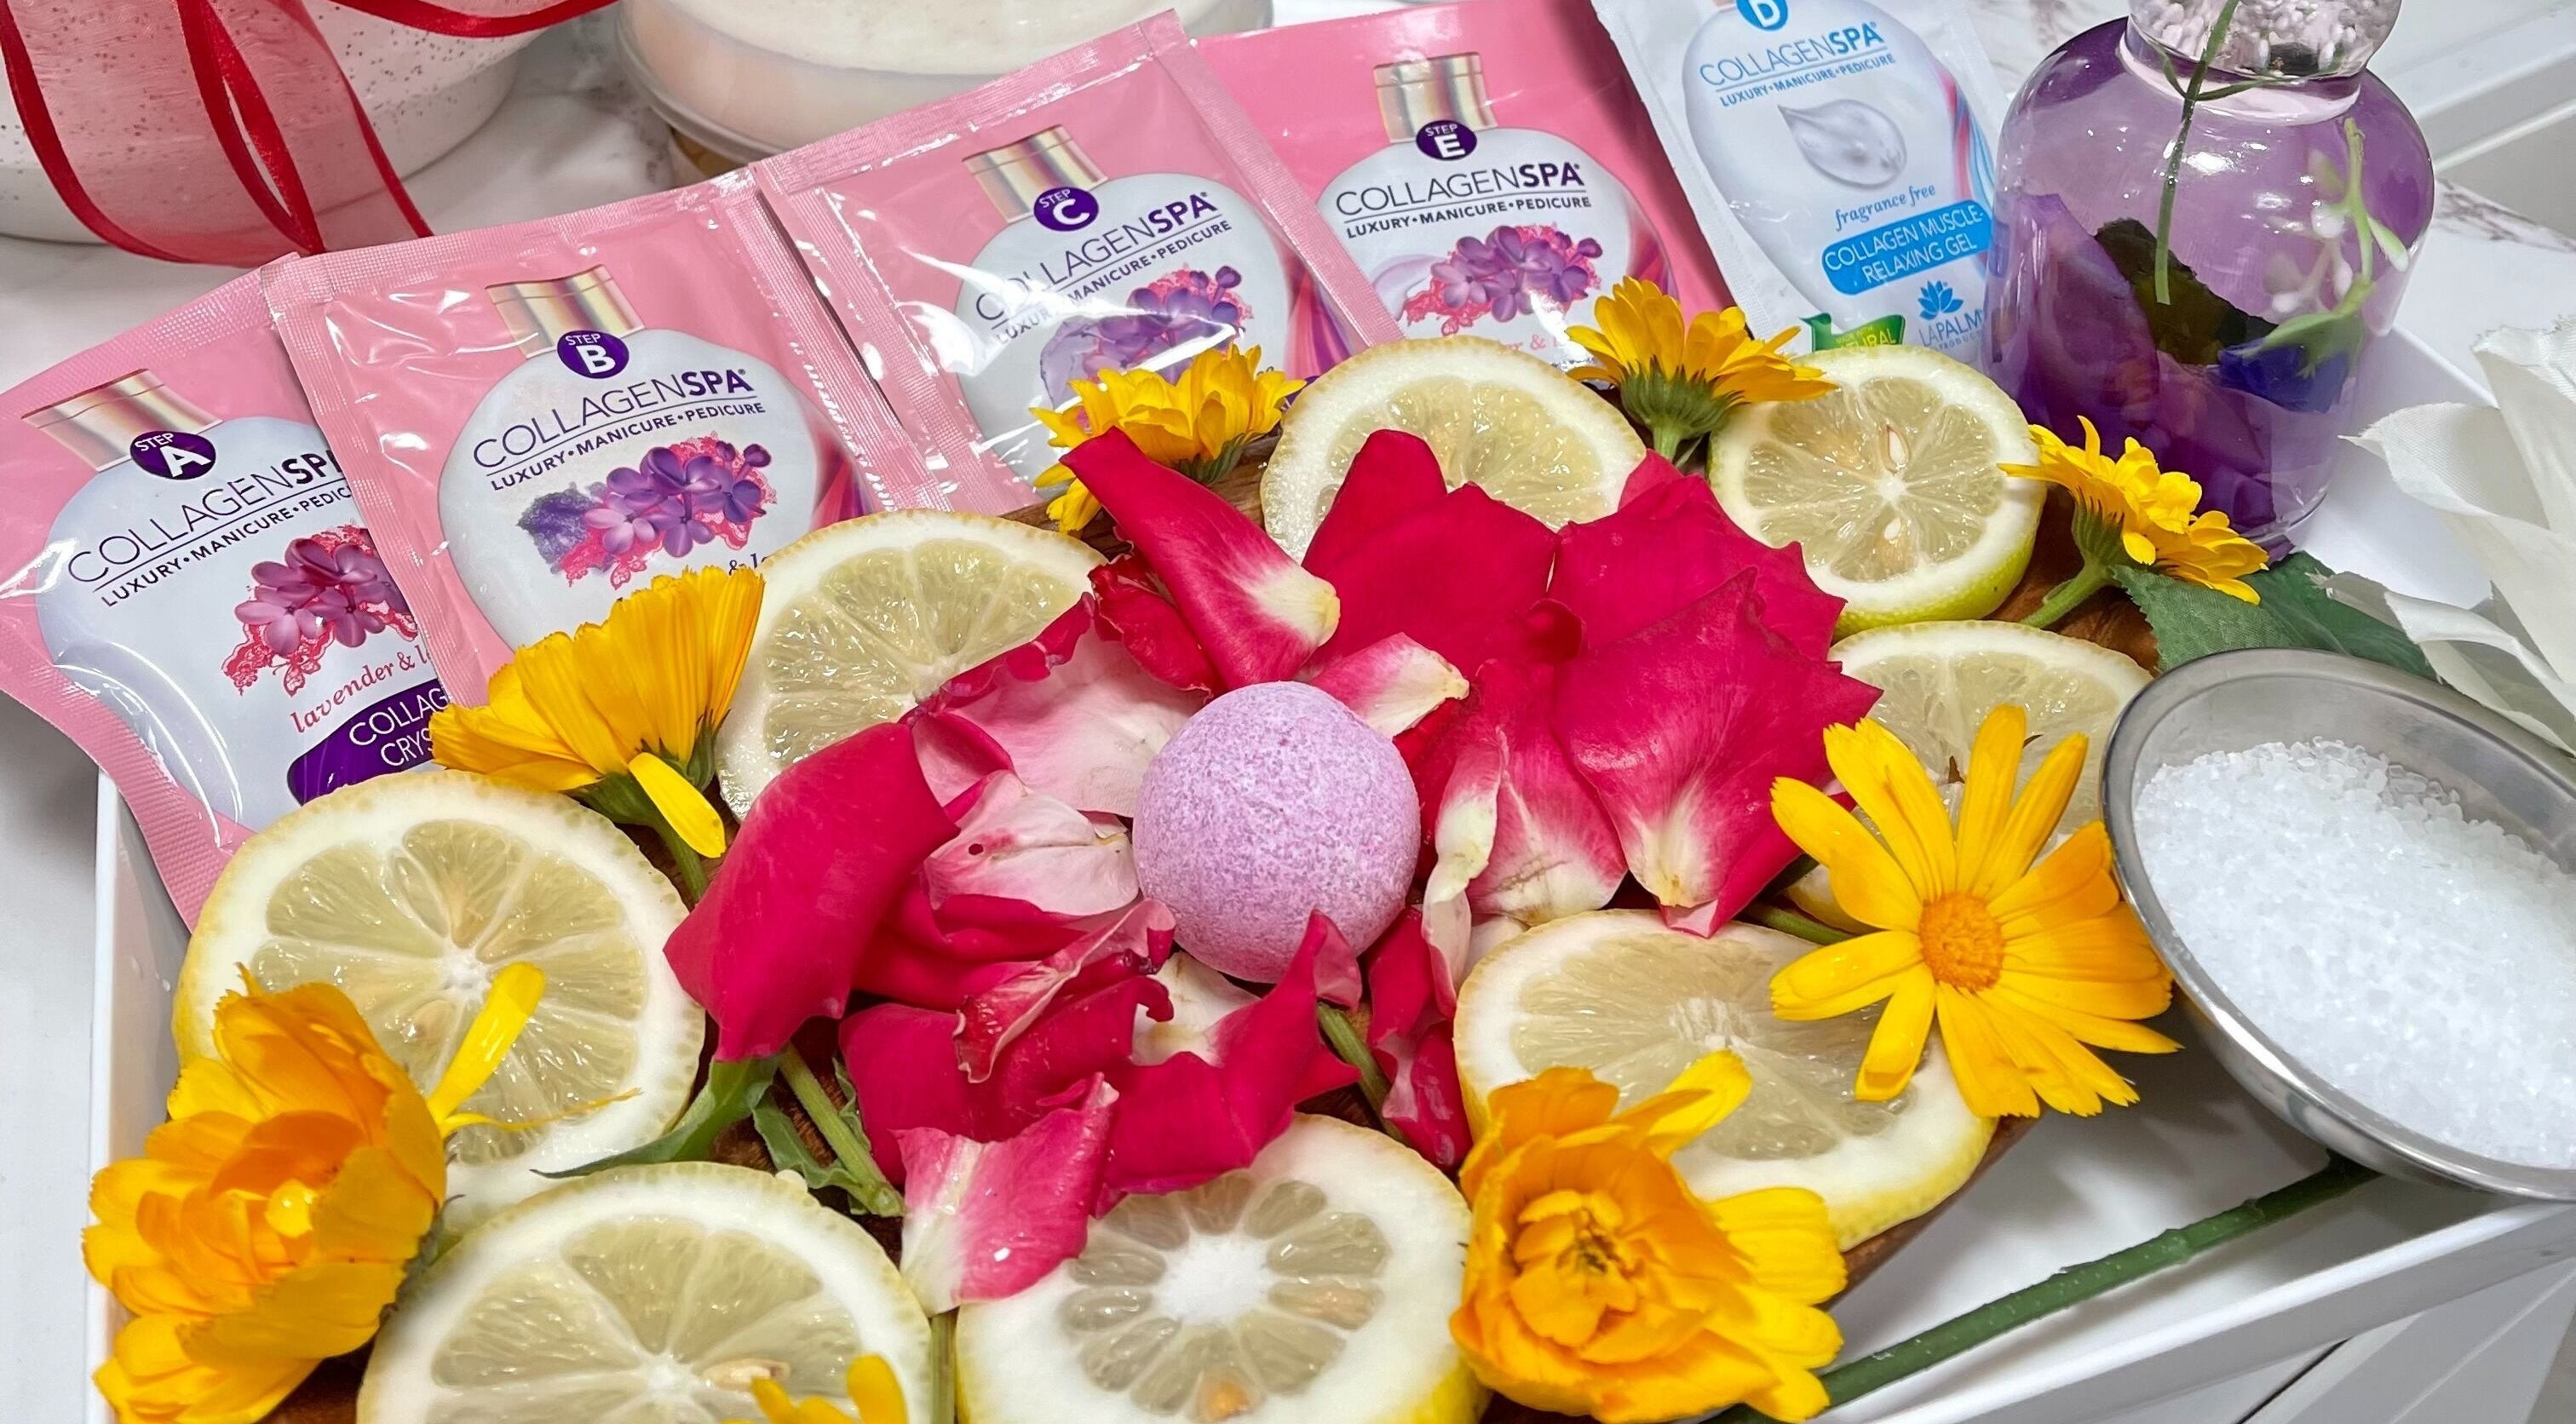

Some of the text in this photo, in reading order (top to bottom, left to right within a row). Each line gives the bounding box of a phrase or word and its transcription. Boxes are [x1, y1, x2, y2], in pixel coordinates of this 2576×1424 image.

[1425, 124, 1458, 137] STEP
[1434, 134, 1465, 159] E
[1038, 189, 1072, 210] STEP
[1053, 198, 1090, 226] C
[1836, 184, 1936, 232] fragrance free
[976, 193, 1218, 320] CLAGENSPA
[1825, 224, 1919, 271] COLLAGEN
[1861, 233, 1977, 284] RELAXING GEL
[564, 332, 601, 347] STEP
[577, 344, 617, 375] B
[134, 432, 175, 452] STEP
[170, 445, 212, 477] A
[299, 485, 352, 511] PEDIC
[290, 662, 394, 733] lavender
[396, 652, 416, 670] &
[349, 687, 449, 746] COLLAG
[380, 727, 434, 767] CRYS
